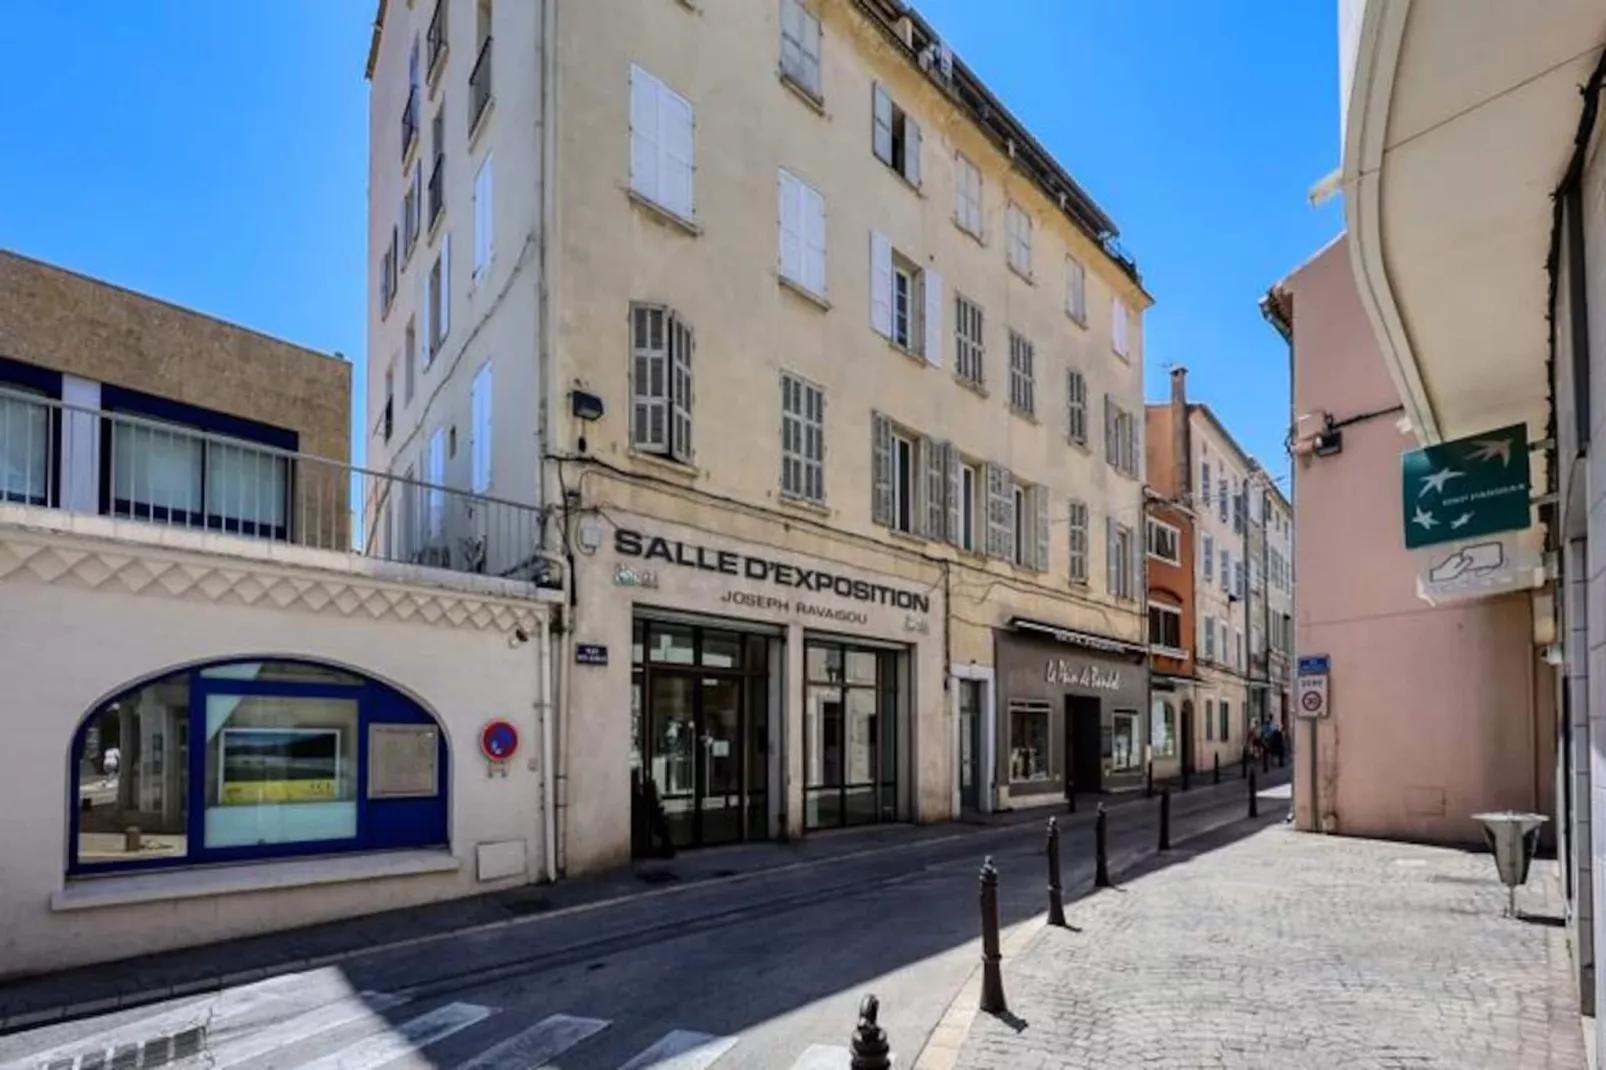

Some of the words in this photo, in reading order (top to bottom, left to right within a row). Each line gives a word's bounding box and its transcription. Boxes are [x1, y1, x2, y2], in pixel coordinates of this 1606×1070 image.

[614, 528, 738, 576] SALLE
[745, 557, 930, 612] D'EXPOSITION
[721, 591, 789, 614] JOSEPH
